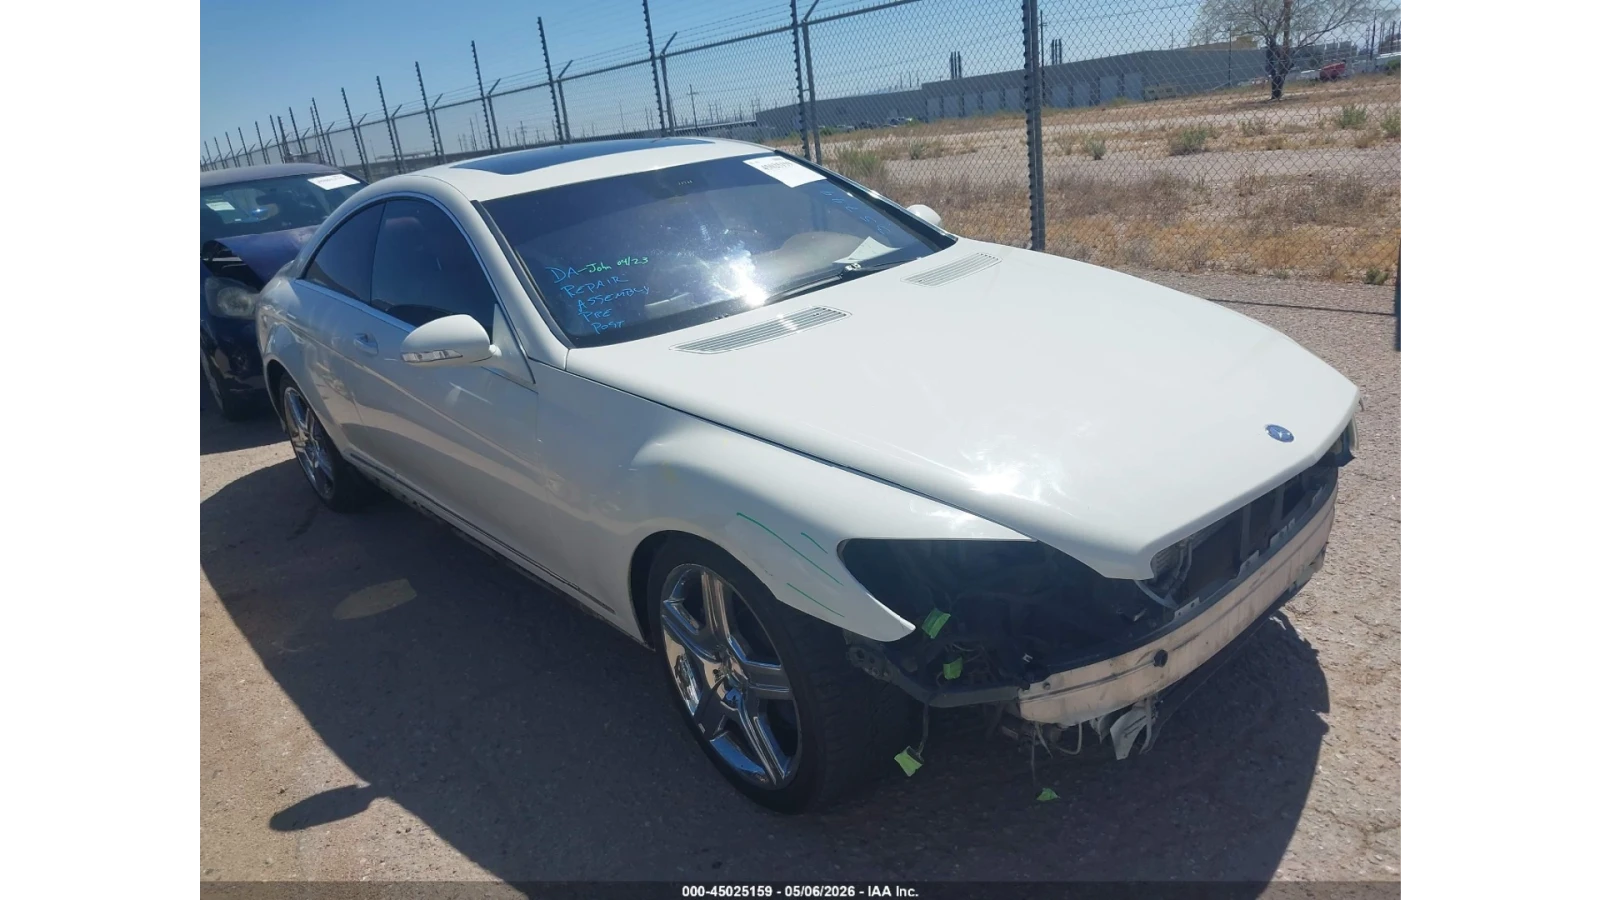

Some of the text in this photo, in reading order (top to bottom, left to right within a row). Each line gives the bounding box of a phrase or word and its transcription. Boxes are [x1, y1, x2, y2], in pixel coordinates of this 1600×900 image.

[561, 275, 629, 298] REPAIR
[578, 285, 650, 310] ASSEMBLY
[579, 308, 612, 322] PRE
